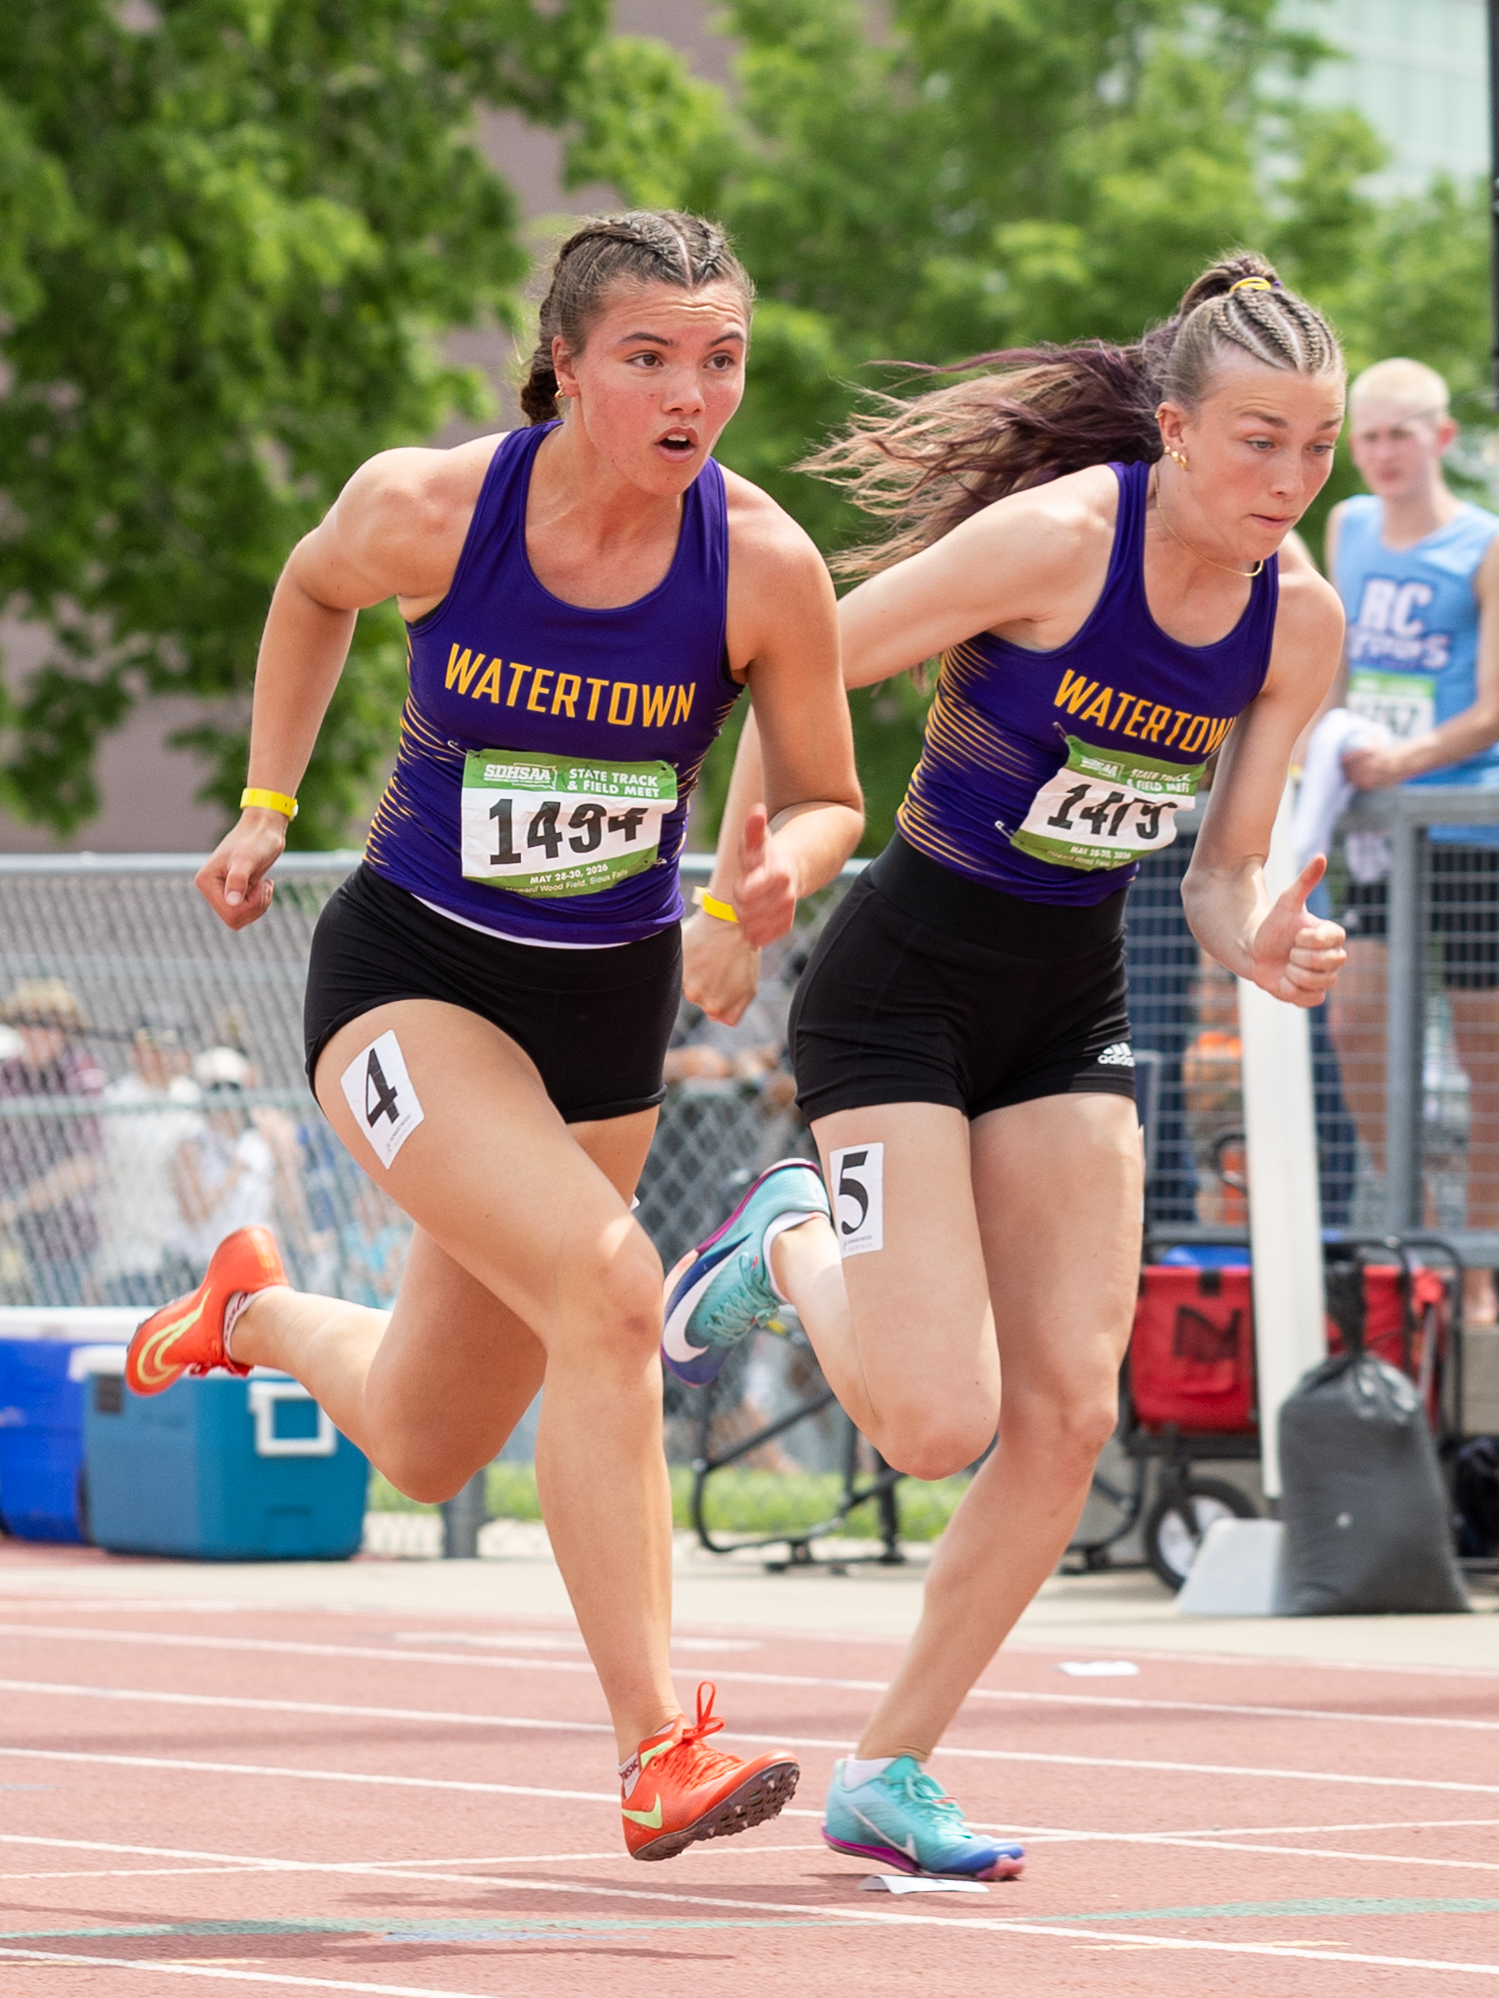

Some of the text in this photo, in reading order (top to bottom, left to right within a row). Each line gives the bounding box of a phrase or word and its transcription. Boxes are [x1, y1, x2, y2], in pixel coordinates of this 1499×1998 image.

[445, 643, 696, 728] WATERTOWN
[1053, 668, 1237, 754] WATERTOW
[483, 763, 551, 781] SDHSAA
[569, 768, 658, 787] STATE TRACK
[567, 780, 660, 797] & FIELD MEET
[1136, 780, 1163, 792] FIELD
[489, 798, 649, 866] 1494
[1070, 845, 1089, 855] MAY
[530, 863, 609, 884] MAY 28-30, 2026
[540, 883, 564, 892] Wood
[589, 874, 611, 885] Sioux
[365, 1047, 399, 1129] 4
[839, 1150, 869, 1235] 5
